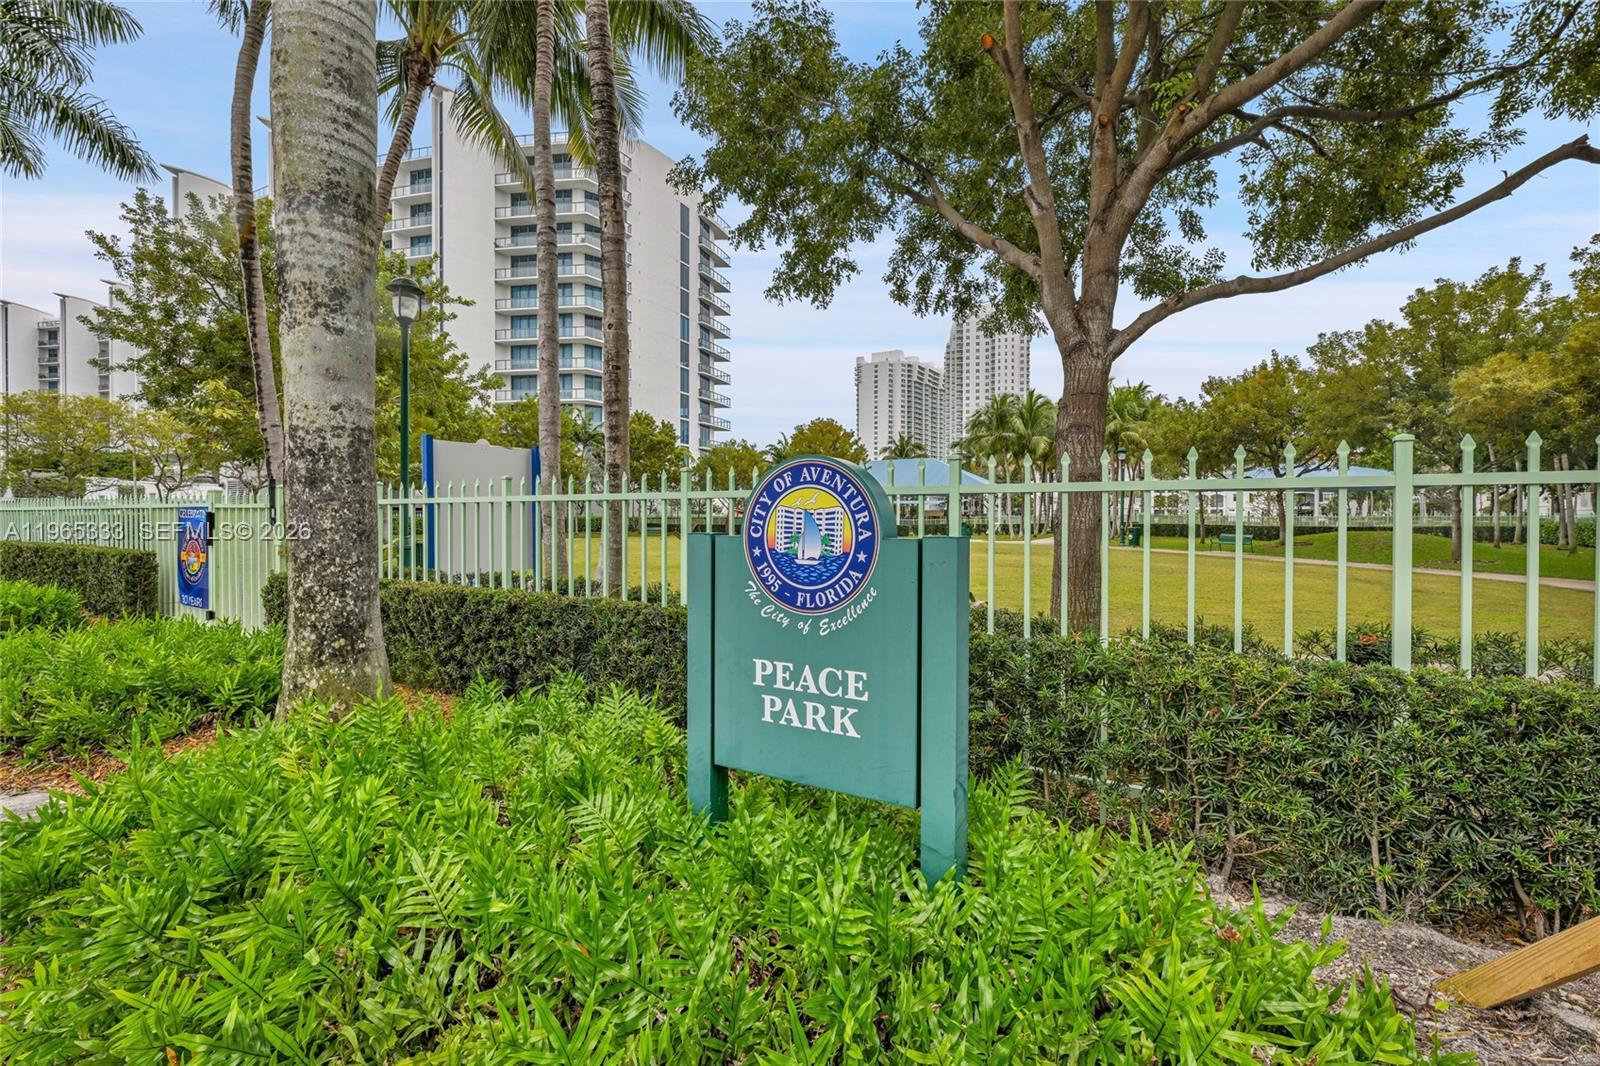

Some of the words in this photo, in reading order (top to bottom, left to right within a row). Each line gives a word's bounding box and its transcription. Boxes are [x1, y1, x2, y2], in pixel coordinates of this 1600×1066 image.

[750, 491, 773, 538] CITY
[773, 472, 793, 493] OF
[800, 467, 872, 541] AVENTURA
[744, 580, 762, 606] The
[760, 604, 790, 628] City
[797, 619, 812, 634] of
[819, 587, 877, 636] Excellence
[756, 562, 782, 593] 1995
[796, 570, 863, 608] FLORIDA
[752, 658, 869, 701] PEACE
[761, 694, 861, 738] PARK
